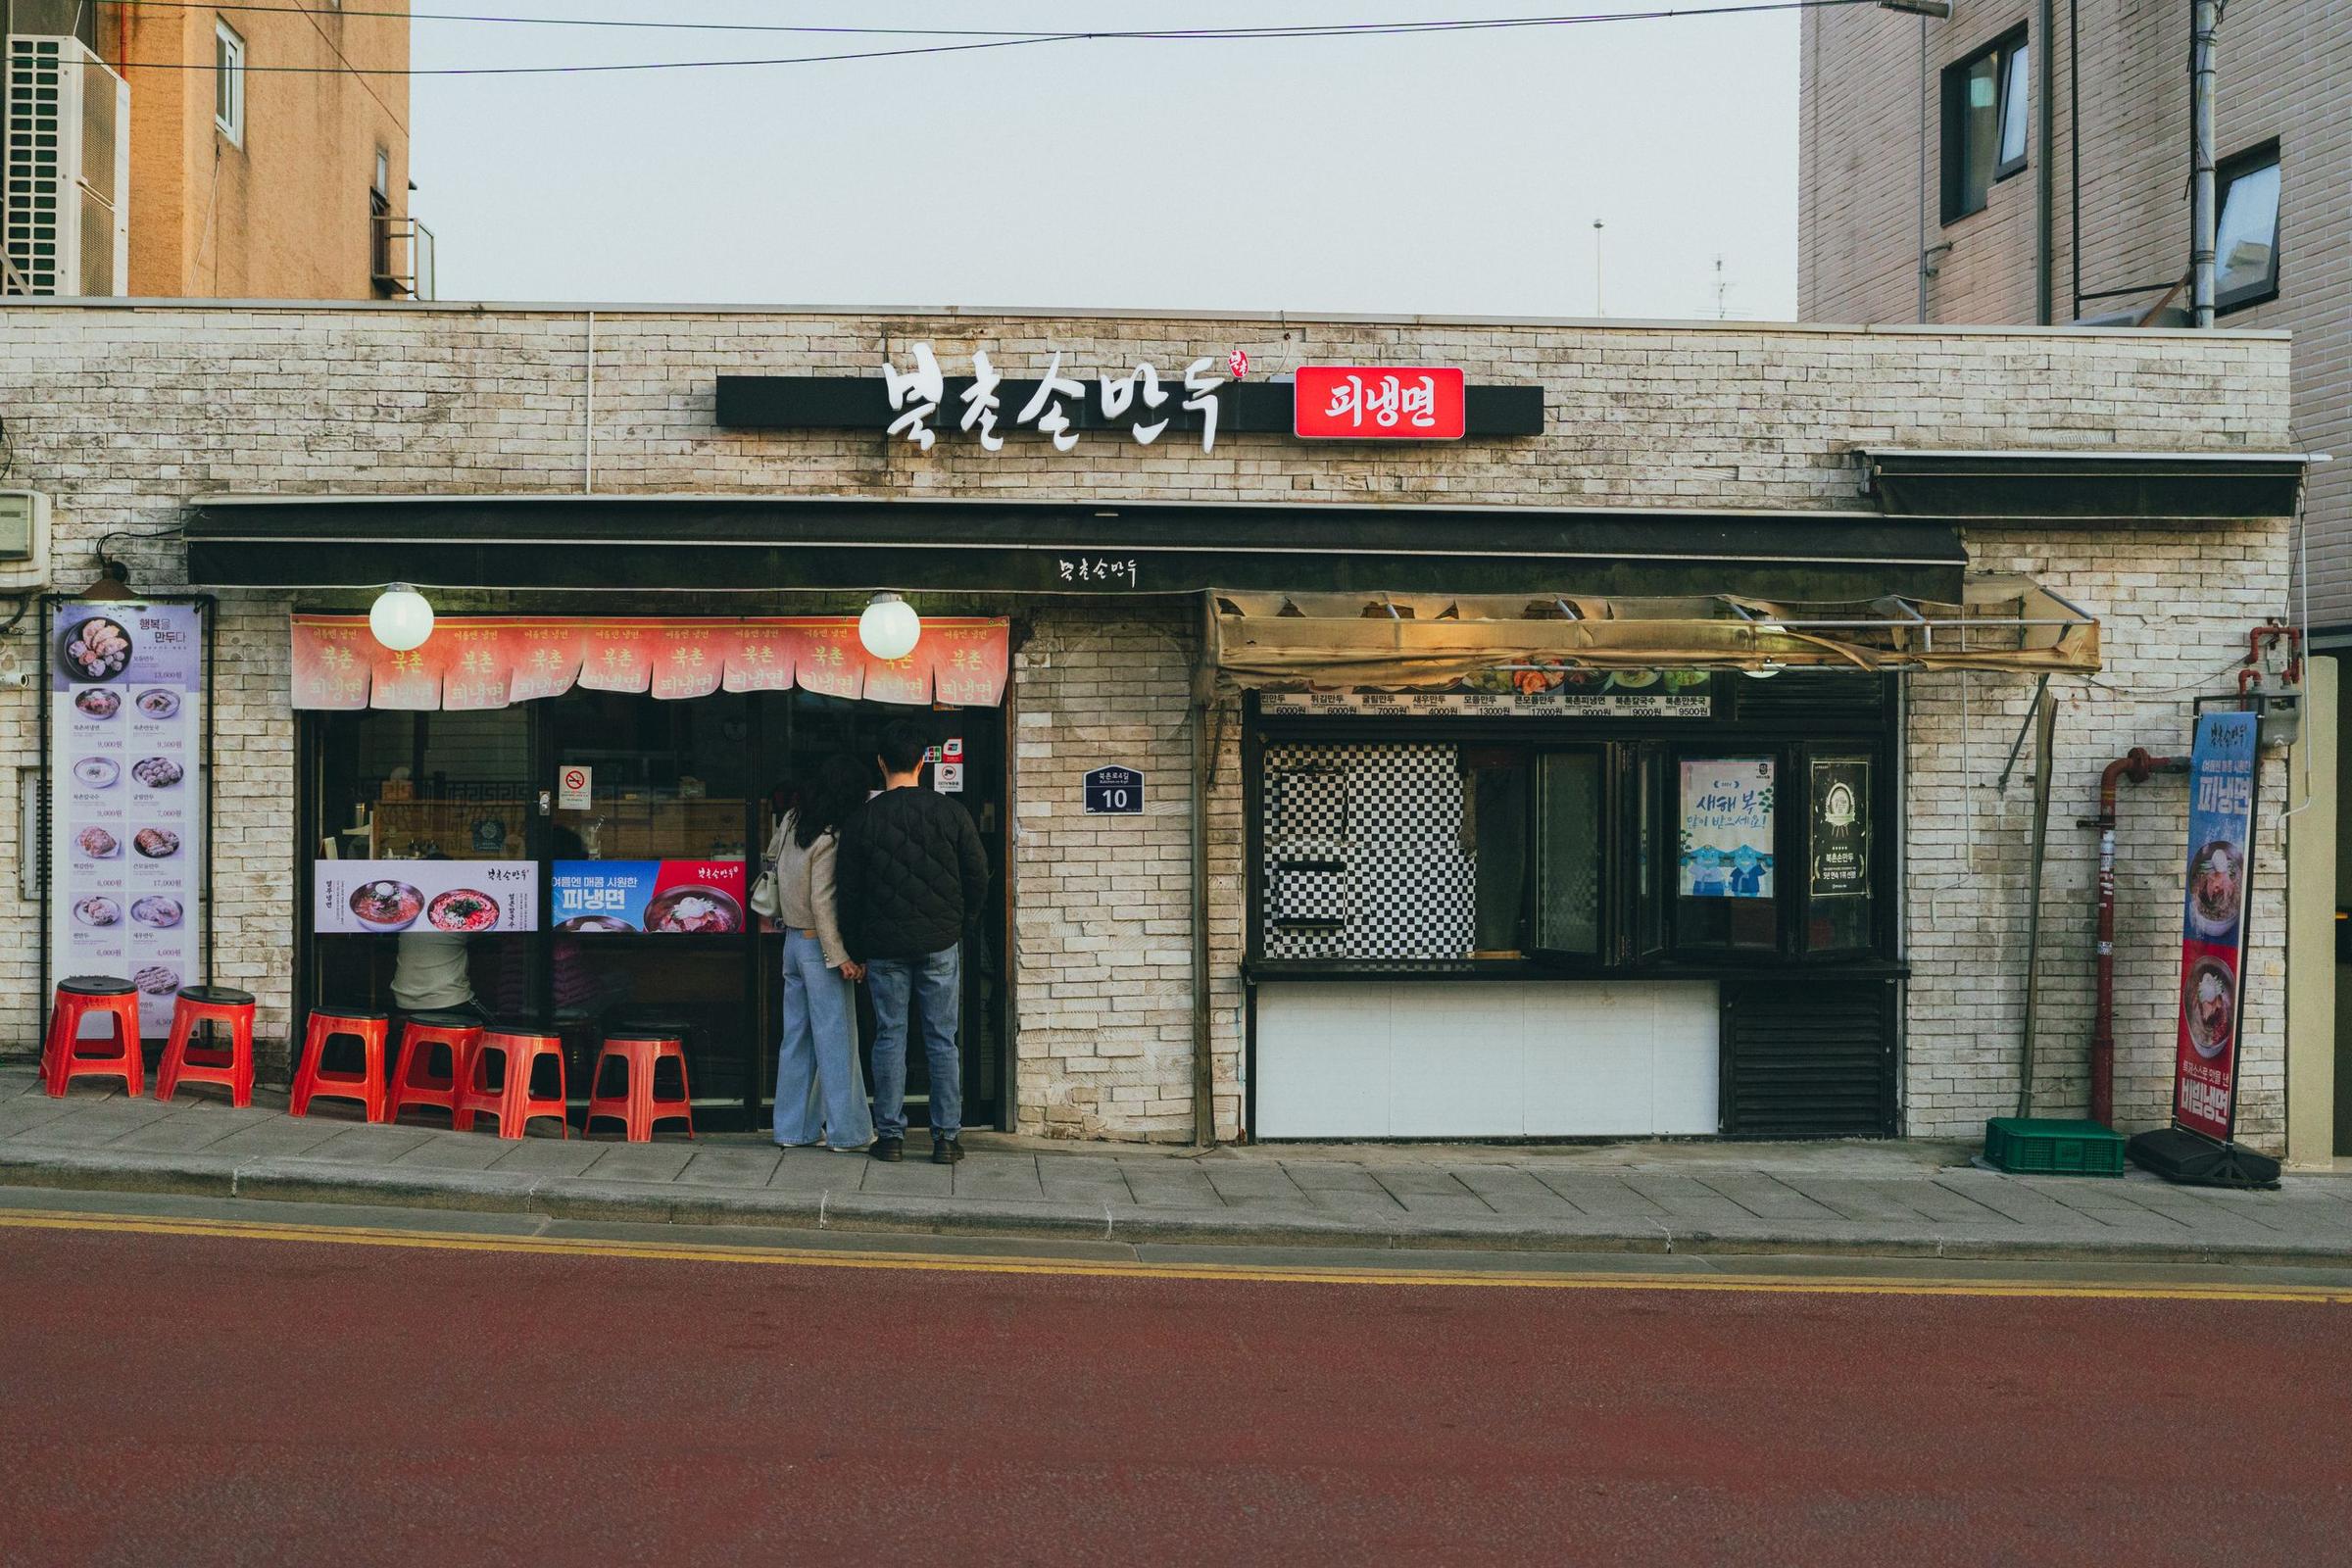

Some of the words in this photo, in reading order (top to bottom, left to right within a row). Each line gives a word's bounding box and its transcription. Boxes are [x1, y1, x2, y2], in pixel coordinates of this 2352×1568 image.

[882, 343, 1225, 454] 북촌손만두
[1325, 375, 1436, 427] 피냉면
[1059, 558, 1137, 588] 북촌손만두
[321, 646, 354, 670] 북촌
[391, 651, 423, 674] 북촌
[461, 651, 494, 674] 북촌
[530, 649, 564, 671] 북촌
[600, 648, 634, 667] 북촌
[672, 647, 705, 667] 북촌
[741, 645, 774, 664] 북촌
[810, 646, 845, 666] 북촌
[950, 649, 983, 671] 북촌
[1413, 695, 1446, 704] 새우만두
[1276, 707, 1305, 715] 6000원
[1327, 707, 1356, 715] 6000원
[1378, 707, 1407, 715] 7000원
[1428, 707, 1458, 715] 4000원
[1479, 707, 1510, 715] 13000원
[1532, 707, 1563, 715] 17000원
[1582, 708, 1611, 716] 9000원
[1632, 708, 1662, 716] 9000원
[1678, 708, 1708, 716] 9500원
[1102, 789, 1127, 808] 10
[1696, 794, 1737, 812] 새해
[1742, 790, 1757, 814] 복
[2198, 776, 2251, 815] 피냉면
[1687, 815, 1708, 829] 많이
[1712, 815, 1766, 829] 받으세요!
[1826, 853, 1854, 862] 북촌손만두
[552, 877, 582, 888] 여름엔
[583, 877, 605, 887] 매콤
[607, 877, 638, 888] 시원한
[563, 889, 625, 910] 피냉면
[2181, 1078, 2229, 1125] 비빔냉면
